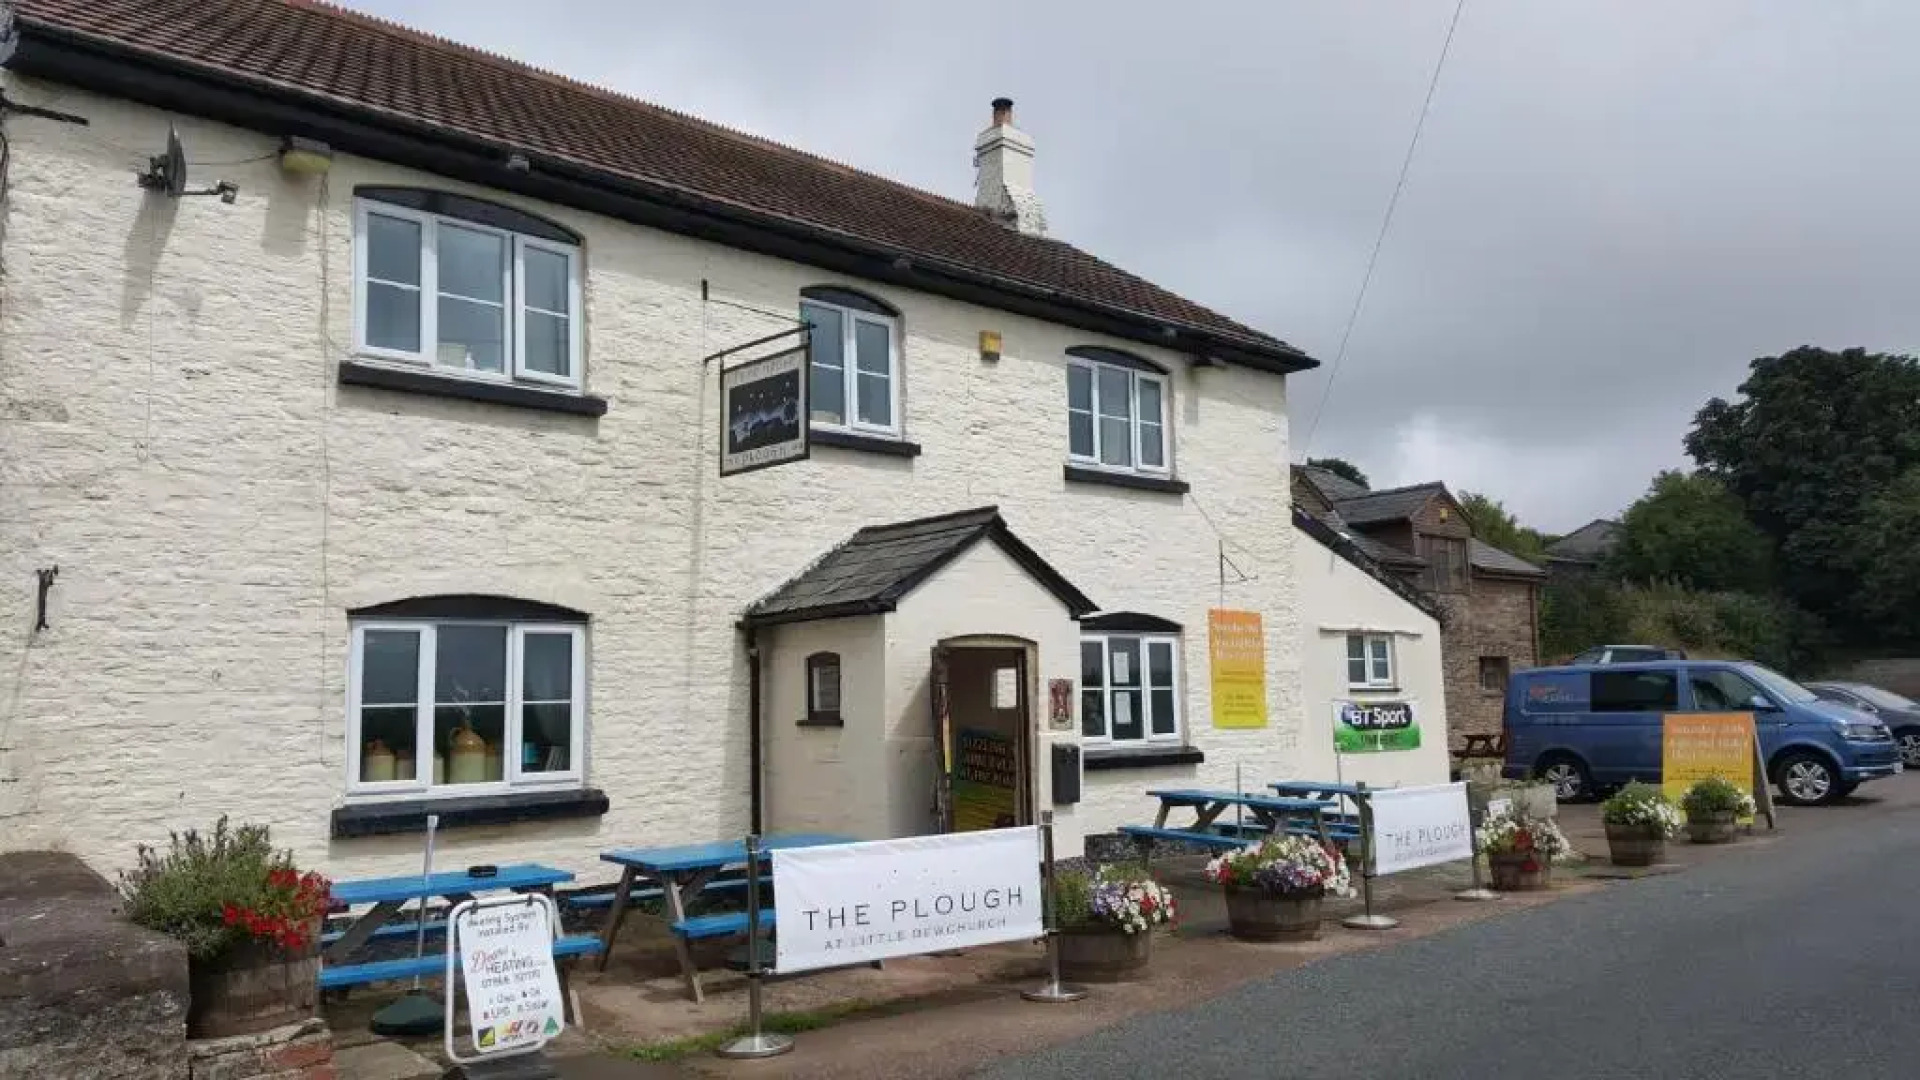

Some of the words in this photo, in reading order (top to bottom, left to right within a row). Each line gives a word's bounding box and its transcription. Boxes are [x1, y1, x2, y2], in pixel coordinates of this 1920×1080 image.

[1351, 710, 1371, 725] BT
[1373, 706, 1407, 728] Sport
[1384, 831, 1410, 847] THE
[802, 903, 871, 931] THE
[891, 885, 1022, 922] PLOUGH
[825, 938, 842, 951] AT
[850, 931, 903, 948] LITTLE
[912, 917, 1006, 939] DEWCHURCH
[485, 956, 535, 974] HEATING
